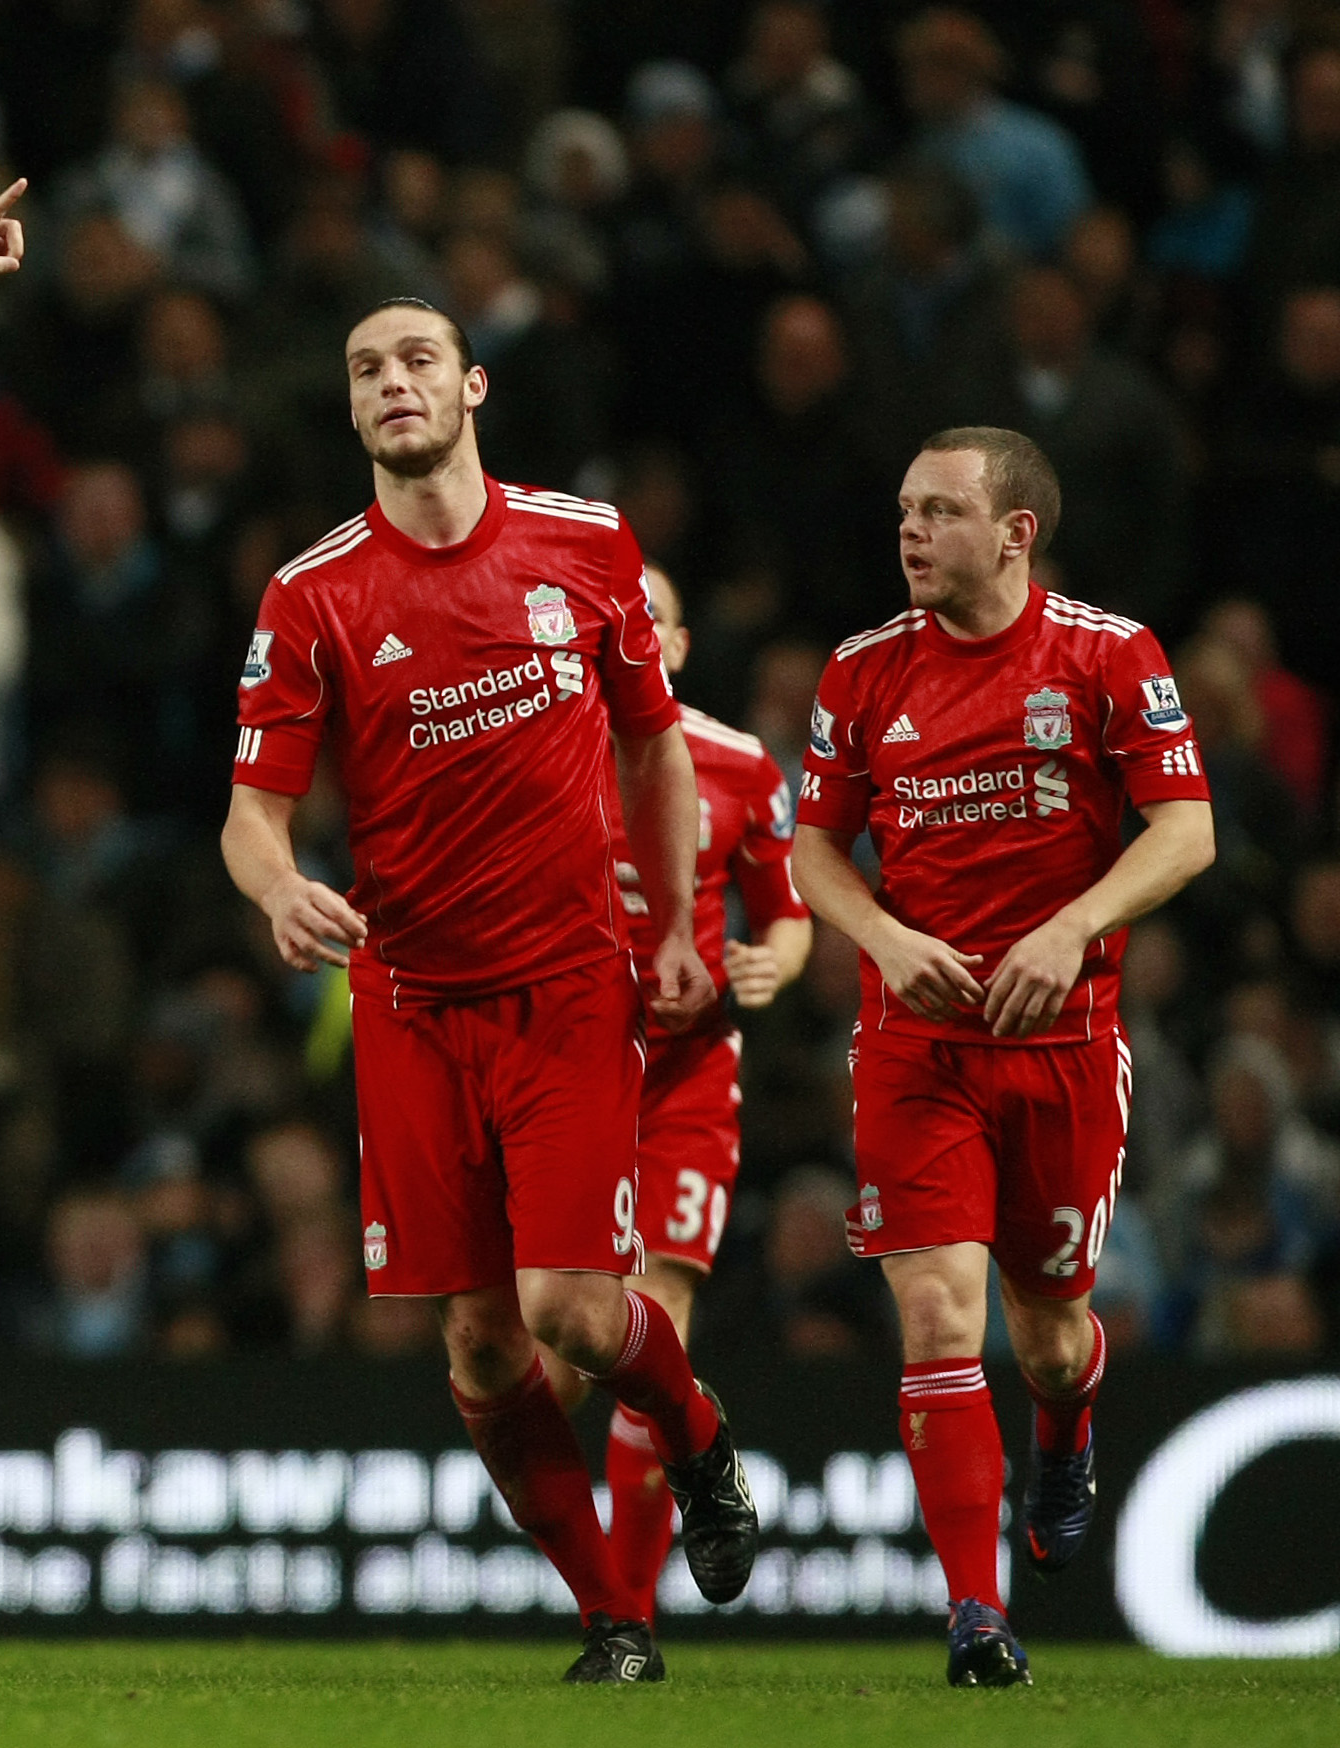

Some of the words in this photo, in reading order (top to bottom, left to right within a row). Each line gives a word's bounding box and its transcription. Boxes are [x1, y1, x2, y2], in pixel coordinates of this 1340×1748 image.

[372, 647, 413, 667] adidas
[409, 653, 544, 715] Standard
[409, 684, 550, 749] Chartered
[882, 732, 920, 743] adidas
[894, 764, 1025, 799] Standard
[899, 796, 1027, 828] Chartered
[612, 1177, 634, 1255] 9
[1042, 1194, 1107, 1276] 20
[354, 1531, 584, 1615] abou
